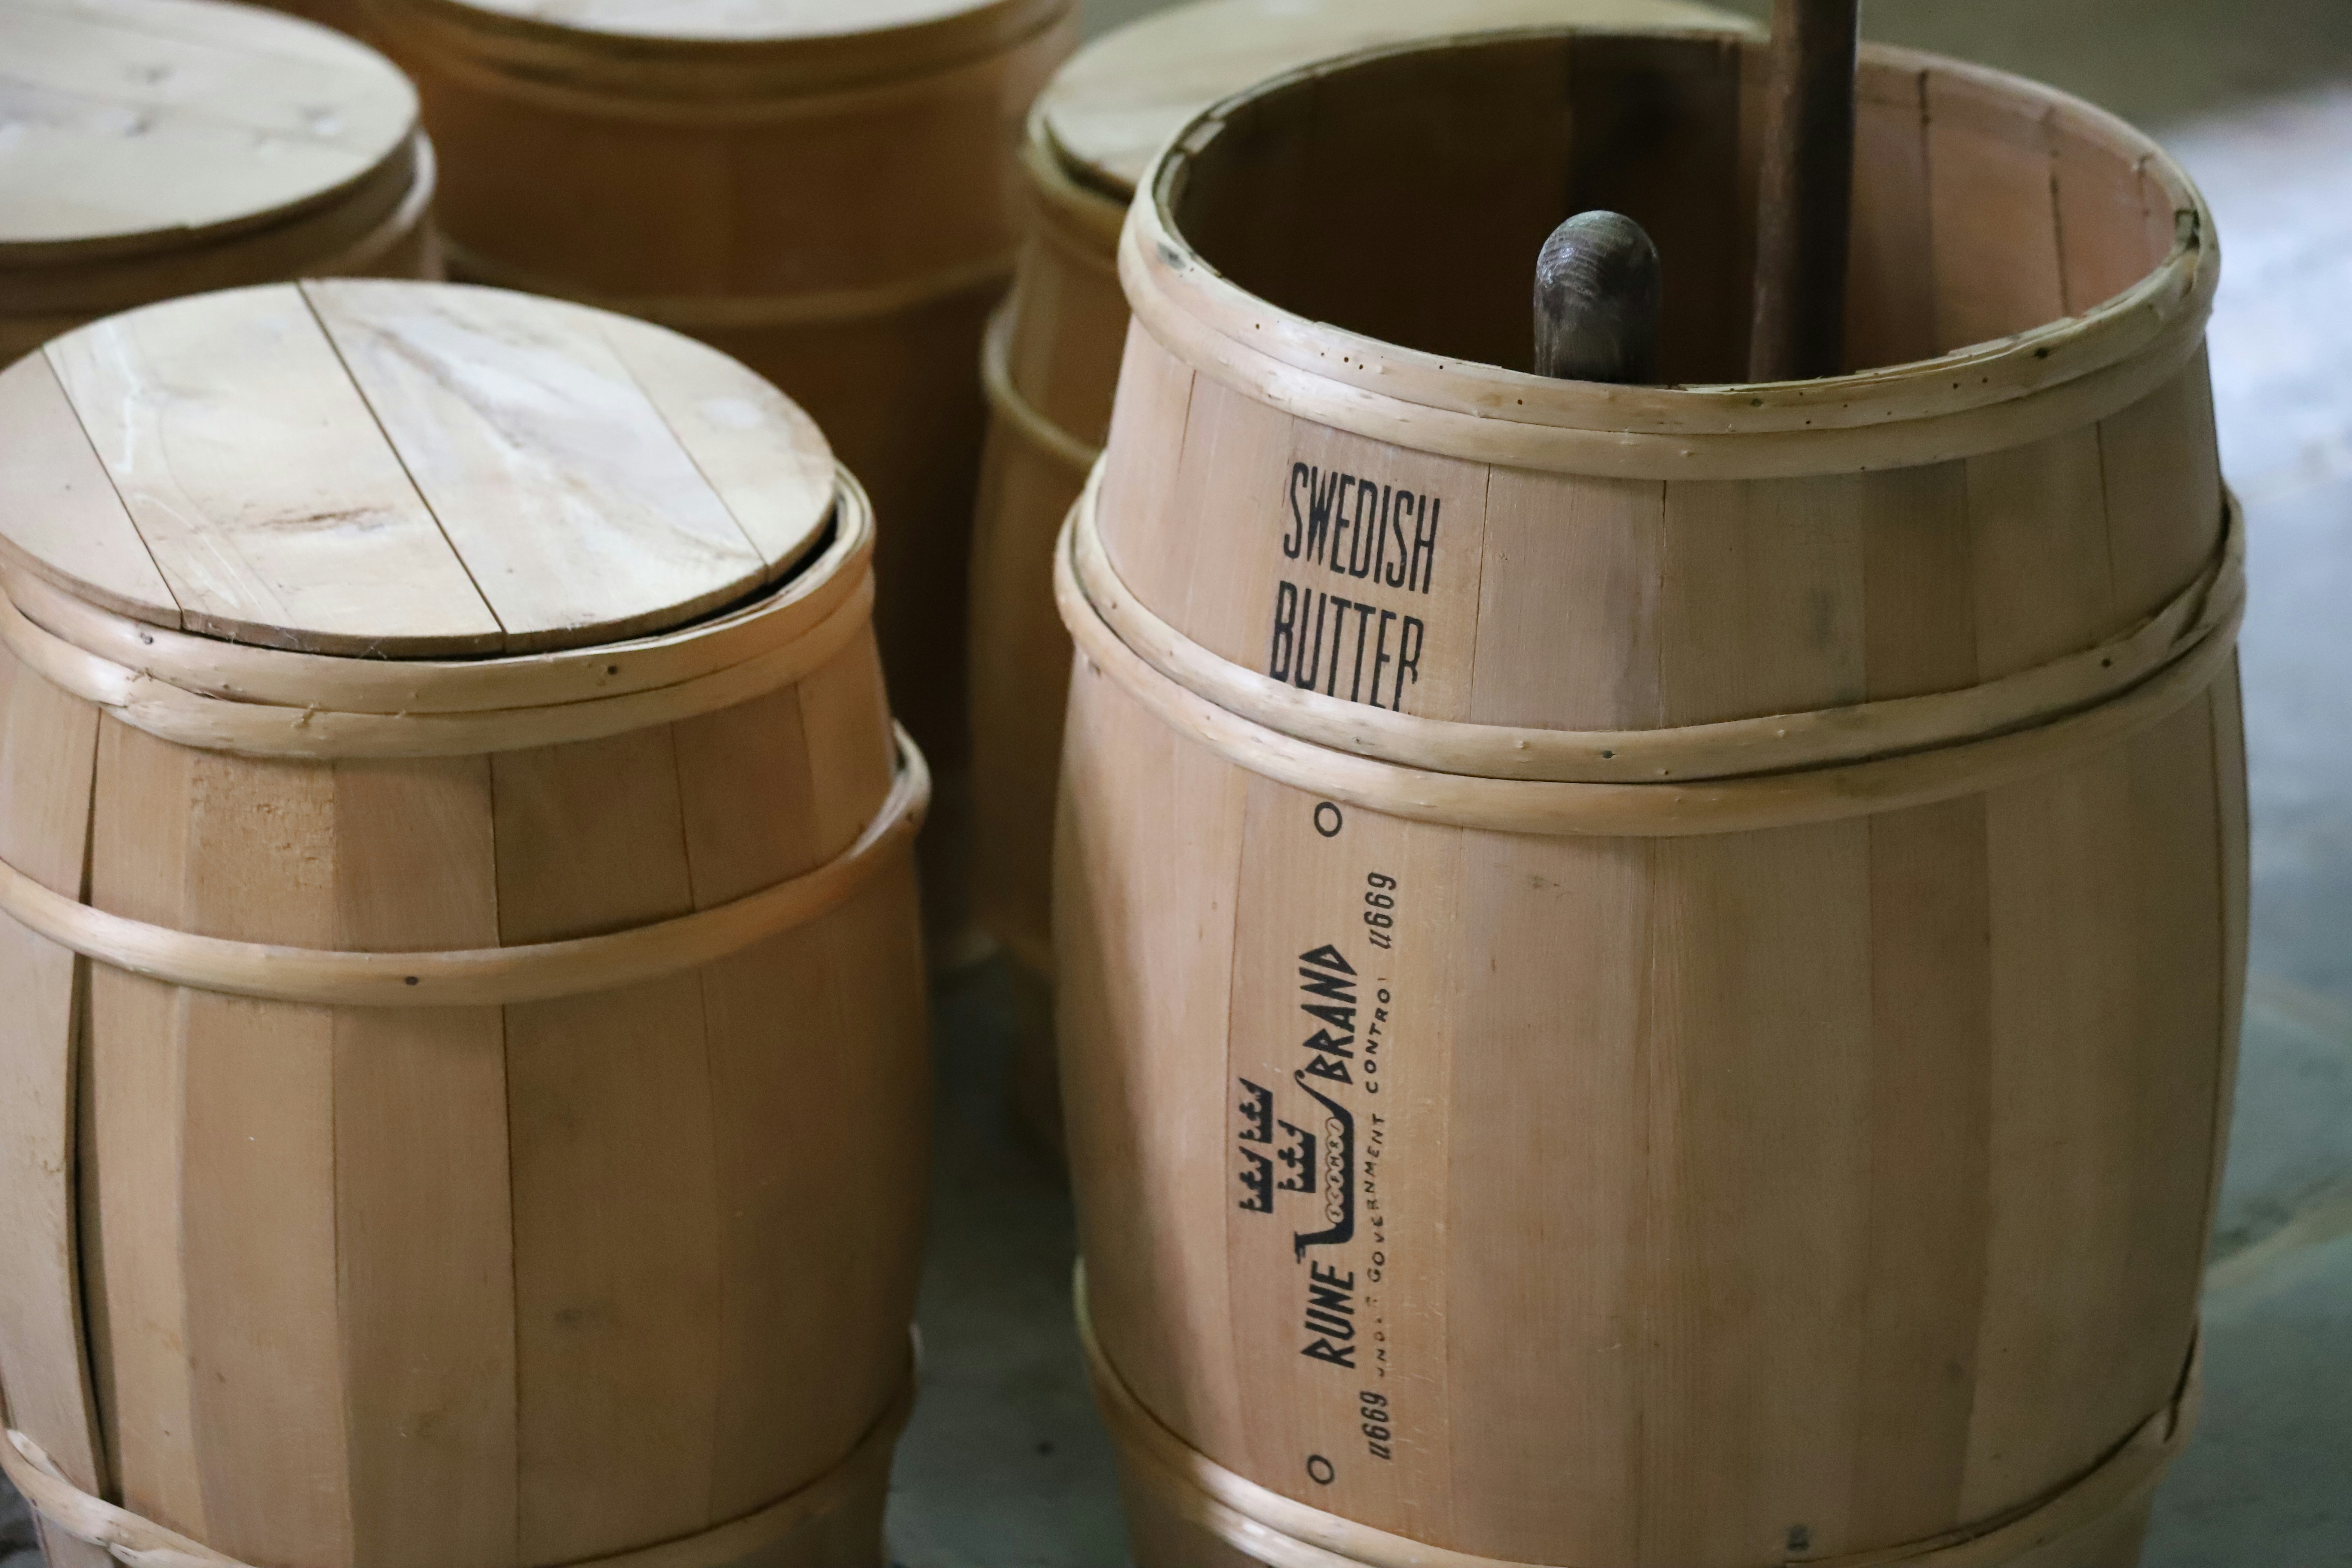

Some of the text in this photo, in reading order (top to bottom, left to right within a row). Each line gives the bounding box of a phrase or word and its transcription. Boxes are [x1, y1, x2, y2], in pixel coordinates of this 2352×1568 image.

[1283, 462, 1440, 594] SWEDISH
[1270, 580, 1424, 712] BUTTER
[1299, 944, 1357, 1368] RUNE BRAND
[1364, 1113, 1385, 1282] GOVERNMENT
